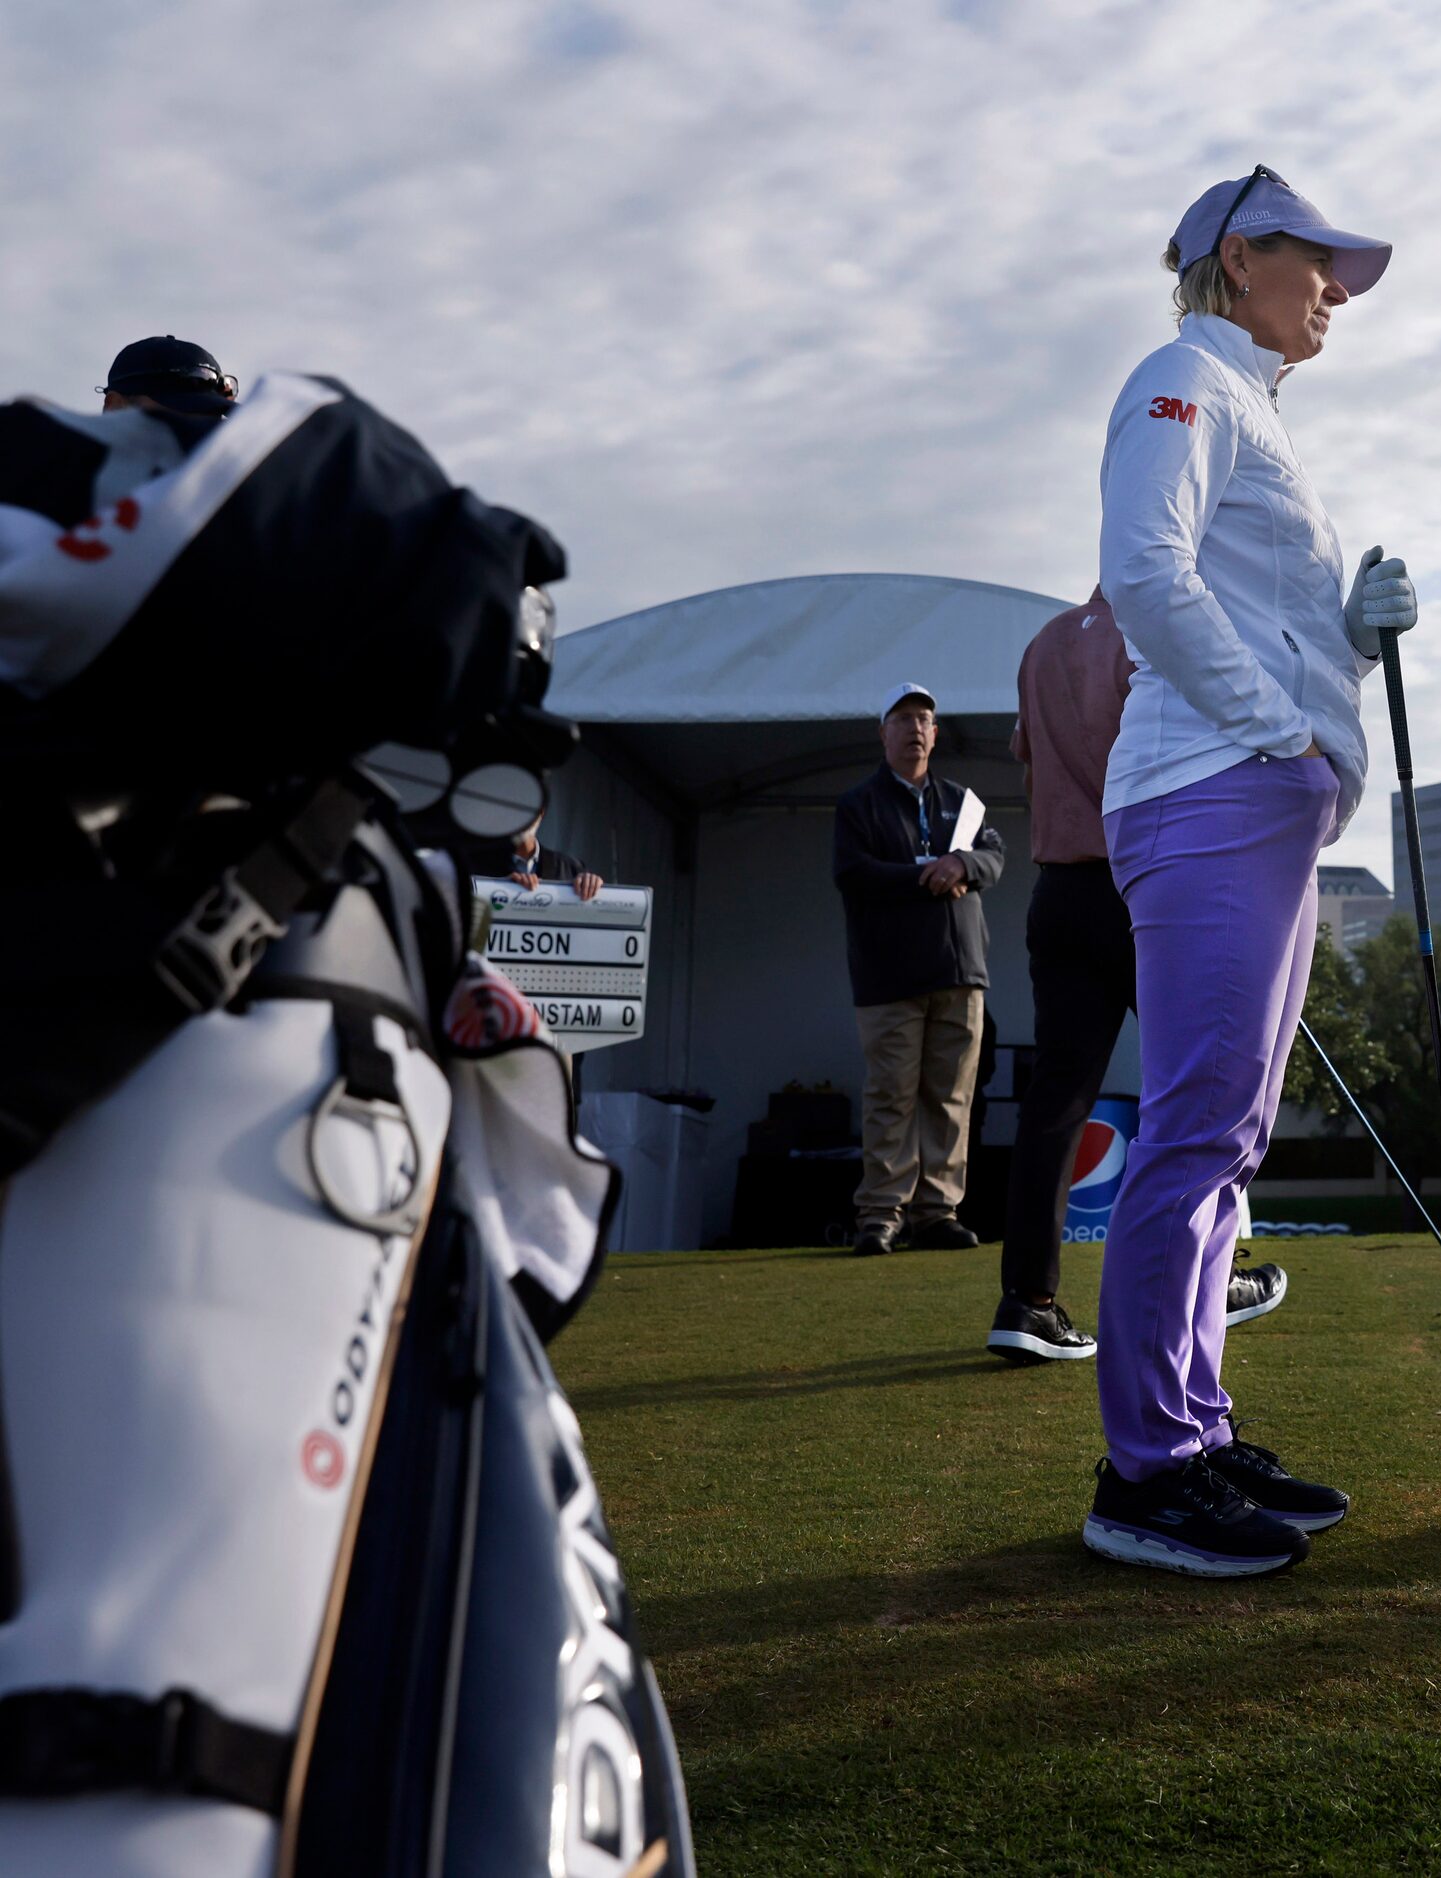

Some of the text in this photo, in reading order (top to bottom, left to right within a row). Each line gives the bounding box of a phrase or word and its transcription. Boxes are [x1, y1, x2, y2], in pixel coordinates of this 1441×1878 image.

[1231, 209, 1272, 225] Hilton
[1148, 396, 1198, 428] 3M
[625, 936, 639, 957] 0
[531, 1002, 602, 1026] NSTAM
[622, 1005, 636, 1027] 0
